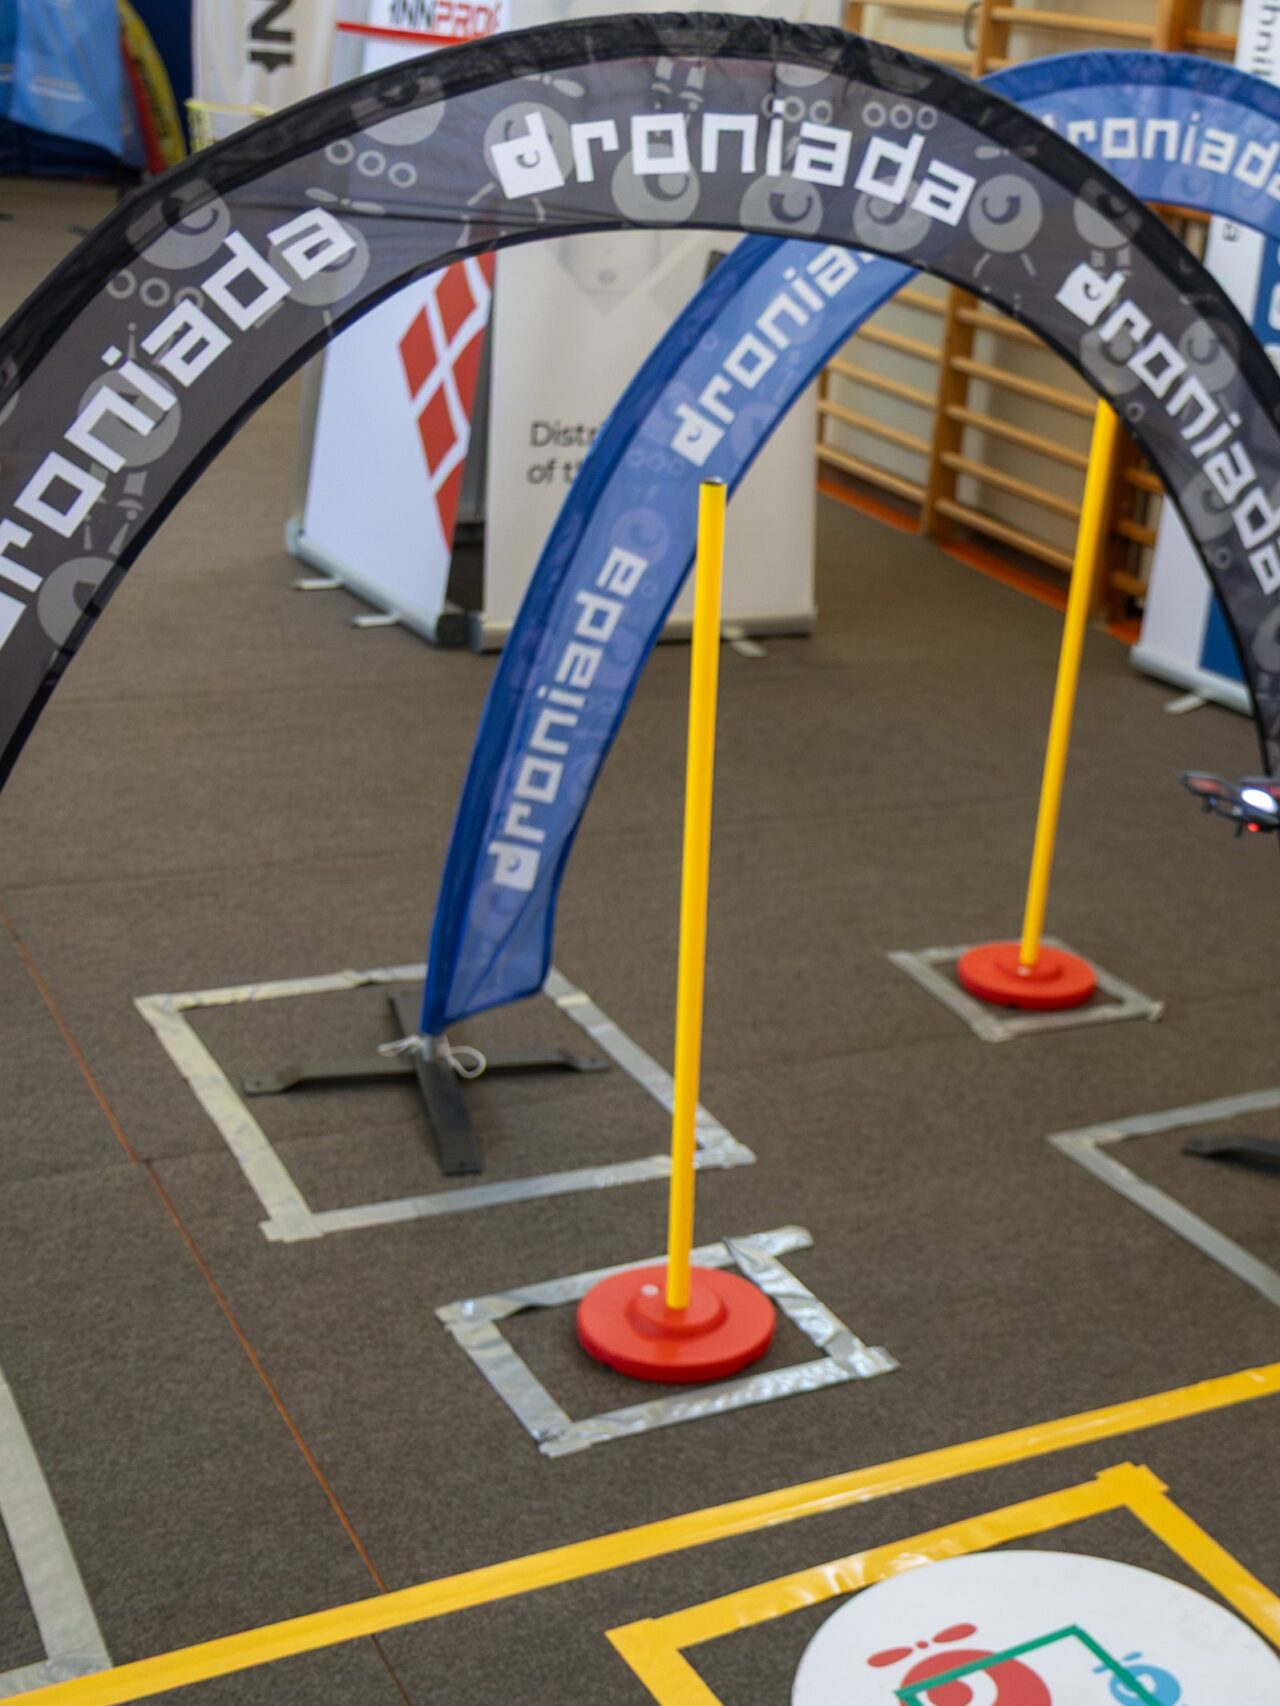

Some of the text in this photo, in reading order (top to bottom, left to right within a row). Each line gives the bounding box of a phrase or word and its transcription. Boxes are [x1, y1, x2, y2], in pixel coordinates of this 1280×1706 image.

[490, 99, 977, 227] droniada
[670, 245, 878, 467] dronia
[488, 546, 649, 891] droniada
